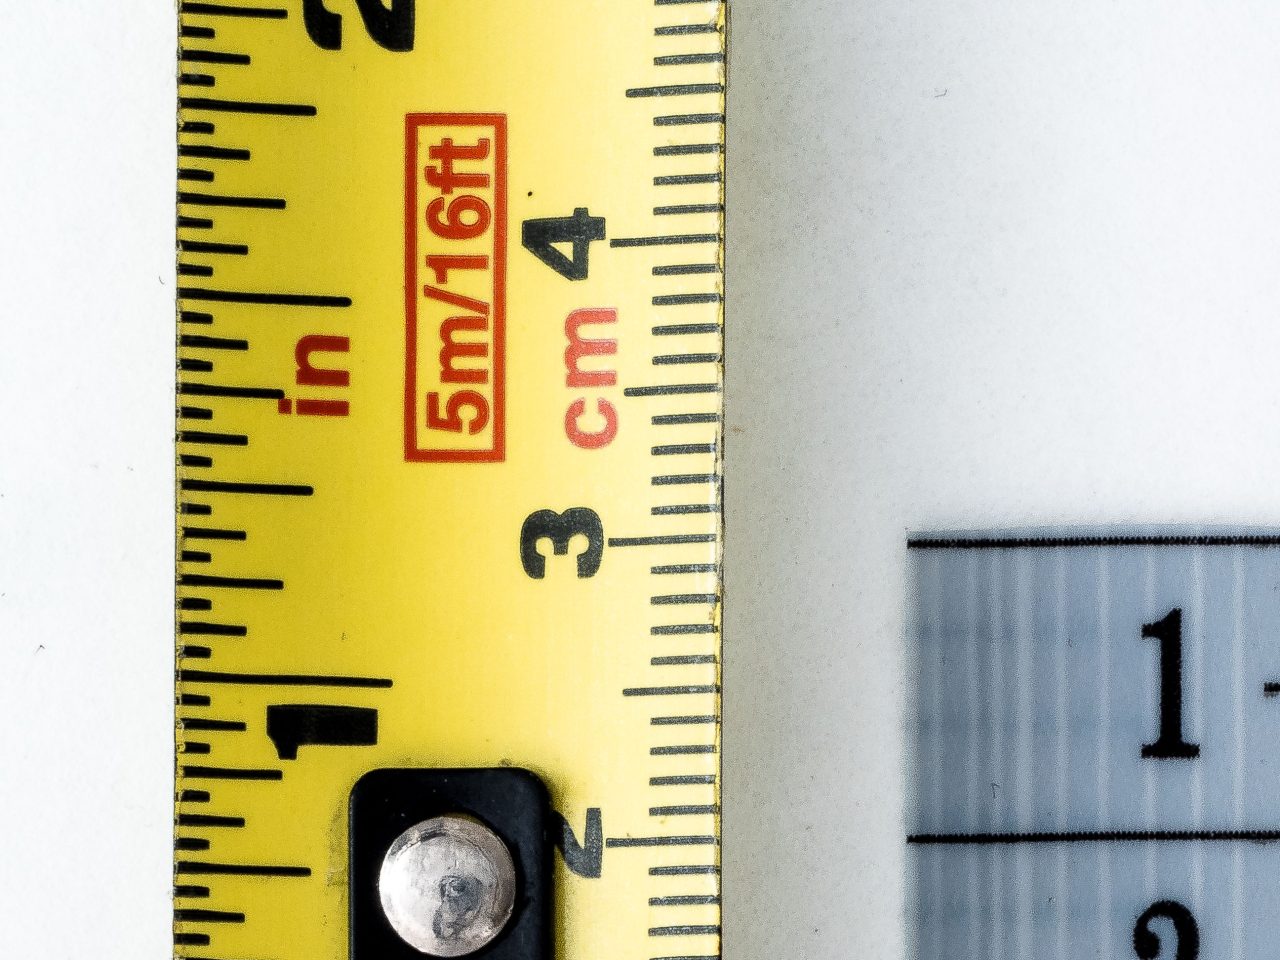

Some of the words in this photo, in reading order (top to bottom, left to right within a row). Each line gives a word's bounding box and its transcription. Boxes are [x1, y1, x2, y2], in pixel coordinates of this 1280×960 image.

[521, 207, 606, 281] 4
[424, 137, 490, 435] 5m/16ft
[278, 334, 350, 416] in
[564, 307, 619, 450] cm
[519, 506, 605, 579] 3
[1141, 607, 1200, 758] 1
[266, 704, 378, 760] 1
